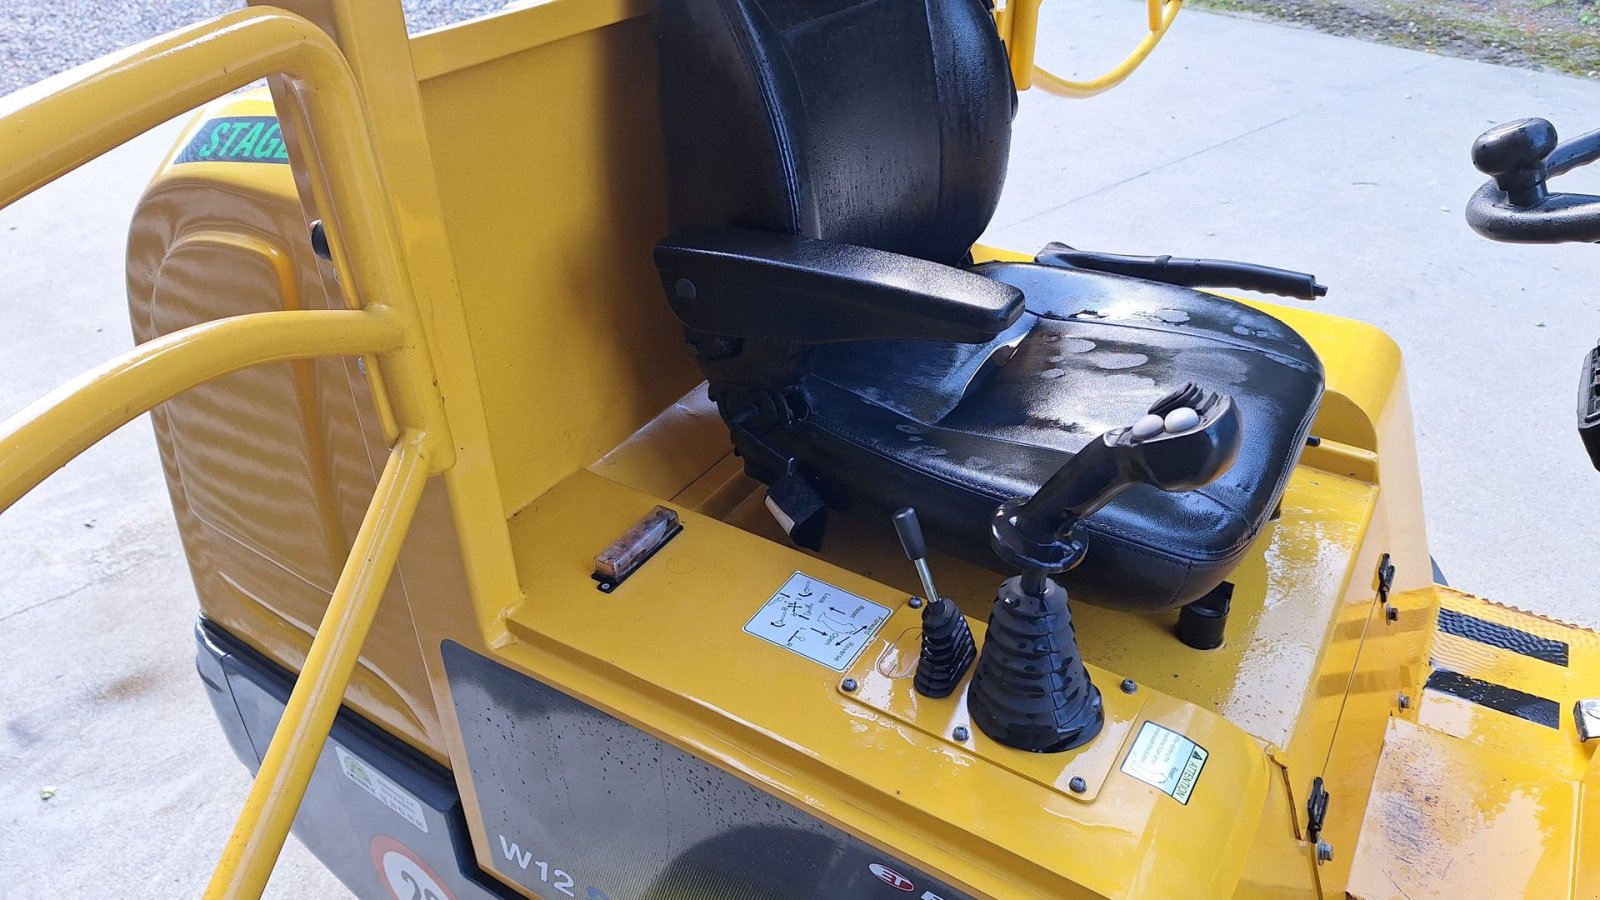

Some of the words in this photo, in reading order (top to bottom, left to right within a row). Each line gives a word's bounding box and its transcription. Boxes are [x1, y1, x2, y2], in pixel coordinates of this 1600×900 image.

[817, 592, 830, 604] Lock
[849, 605, 864, 618] Reset
[863, 616, 883, 635] Forward
[824, 632, 838, 645] Open
[833, 641, 854, 662] Reverse
[1175, 760, 1198, 798] ATTENTION
[499, 834, 574, 897] W12
